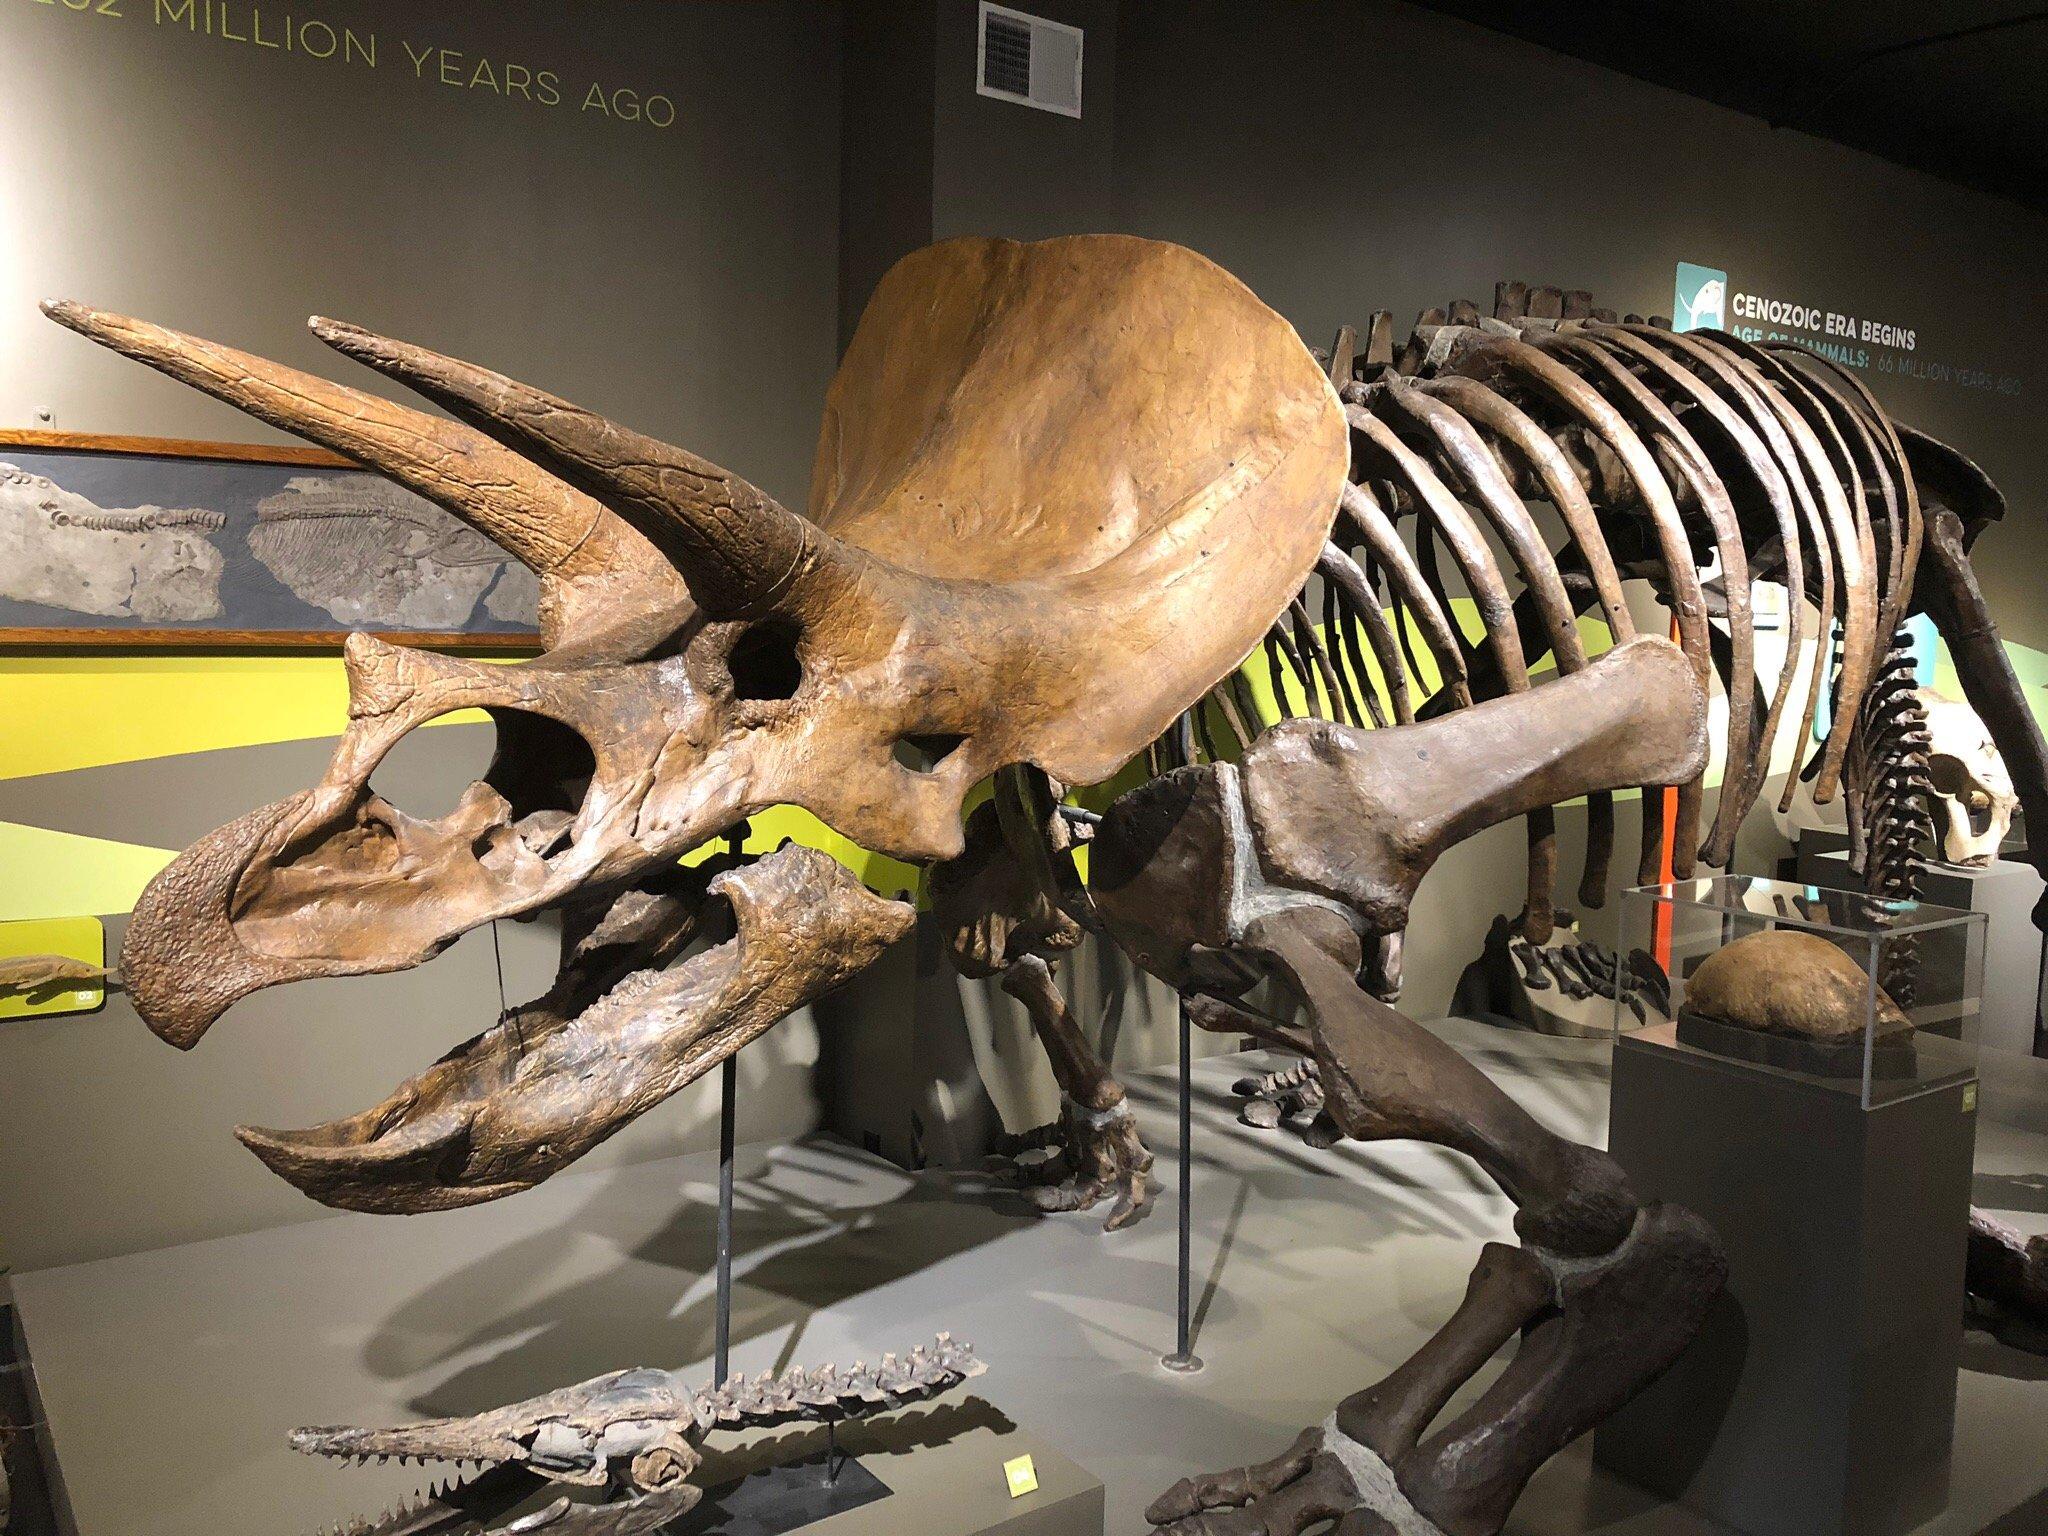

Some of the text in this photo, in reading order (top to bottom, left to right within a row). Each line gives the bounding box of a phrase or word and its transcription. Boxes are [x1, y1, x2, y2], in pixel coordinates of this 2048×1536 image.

[155, 0, 675, 127] MILLION YEARS AGO
[1732, 293, 1916, 351] CENOZOIC ERA BEGINS
[1732, 325, 1763, 343] AGE
[1878, 354, 1893, 374] 66
[1899, 358, 1950, 381] MILLION
